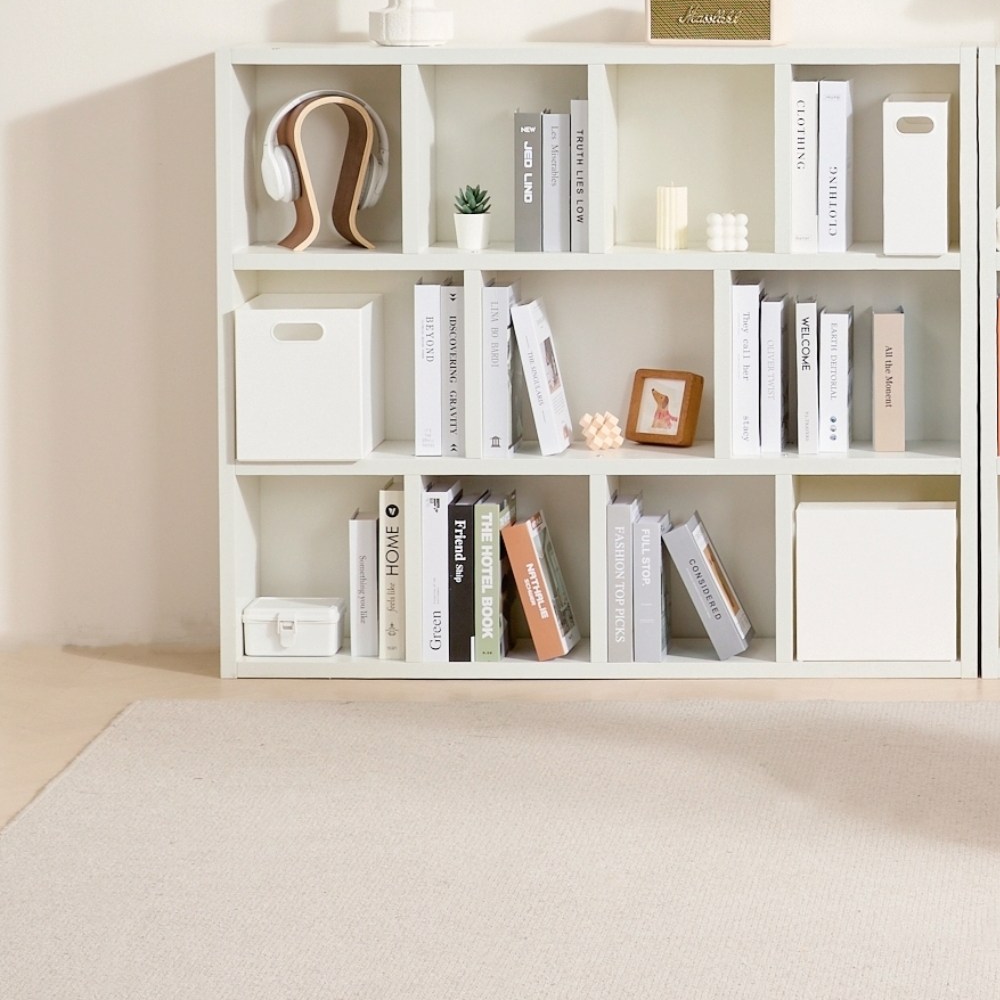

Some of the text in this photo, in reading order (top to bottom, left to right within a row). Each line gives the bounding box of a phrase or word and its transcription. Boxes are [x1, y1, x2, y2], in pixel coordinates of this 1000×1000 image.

[797, 99, 806, 170] CLOTHING
[523, 173, 533, 204] LIND
[576, 130, 584, 224] TRUTH LIES LOW
[829, 166, 838, 237] CLOTHING
[425, 316, 434, 362] BEYOND
[801, 317, 811, 371] WELCOME
[830, 322, 838, 350] EARTH
[885, 345, 893, 358] All
[885, 360, 893, 375] the
[450, 390, 458, 435] GRAVITY
[386, 526, 399, 576] HOME
[454, 519, 466, 584] Friend Ship
[480, 512, 493, 543] THE
[641, 529, 650, 554] FULL
[358, 555, 367, 624] Something you like
[481, 544, 493, 594] HOTEL
[526, 563, 549, 620] NATHALIE
[615, 526, 625, 644] FASHION TOP PICKS
[688, 558, 722, 621] CONSIDERED
[429, 610, 442, 651] Green
[481, 596, 493, 639] BOOK
